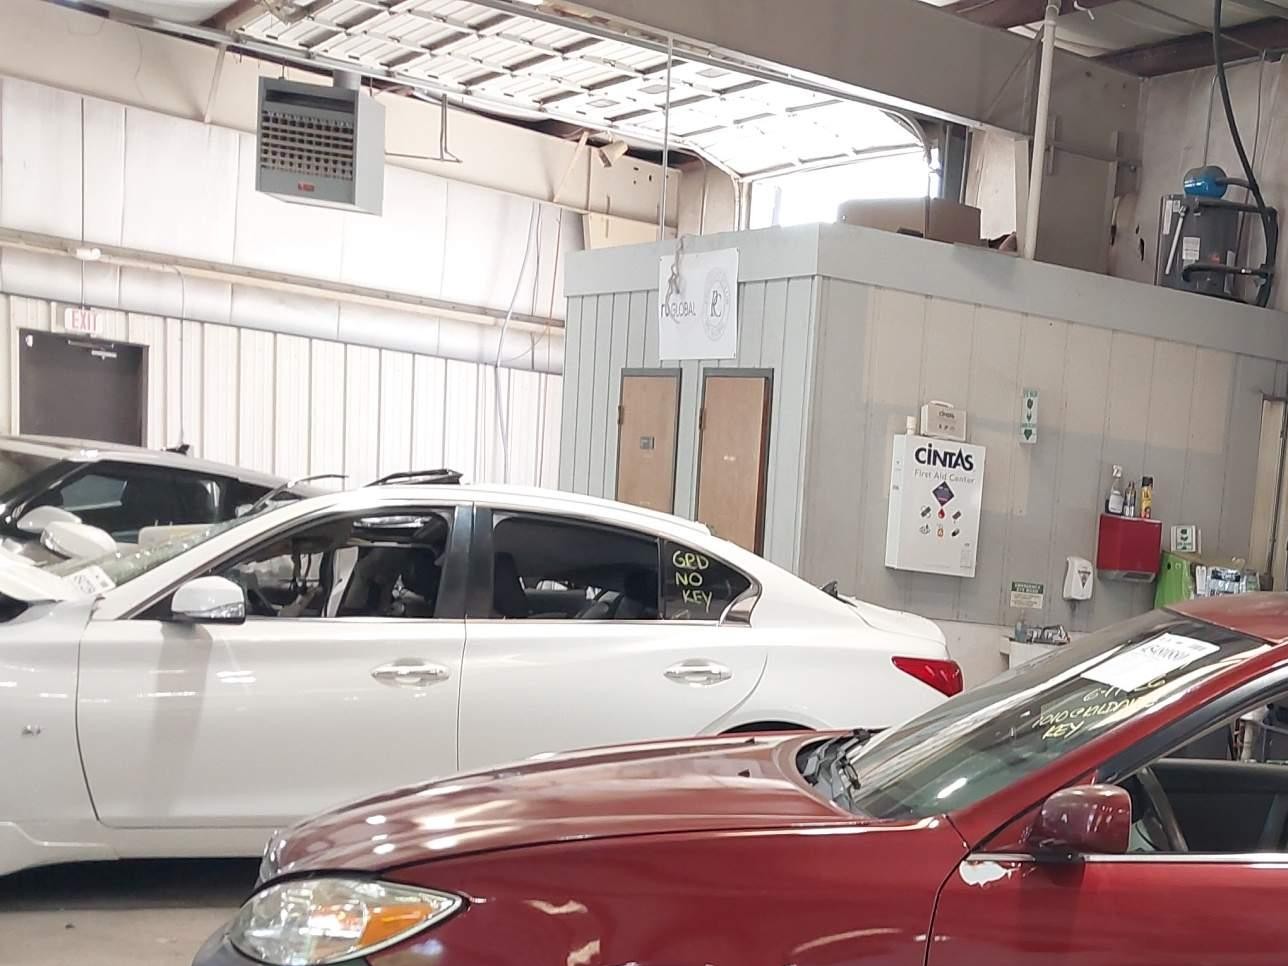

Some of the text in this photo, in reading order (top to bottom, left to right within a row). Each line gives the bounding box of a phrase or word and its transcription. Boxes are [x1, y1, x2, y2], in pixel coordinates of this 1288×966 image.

[71, 309, 97, 332] EXIT
[914, 468, 976, 484] First Aid Center
[675, 571, 703, 587] NO
[682, 589, 713, 613] KEY
[1042, 720, 1085, 740] KEY
